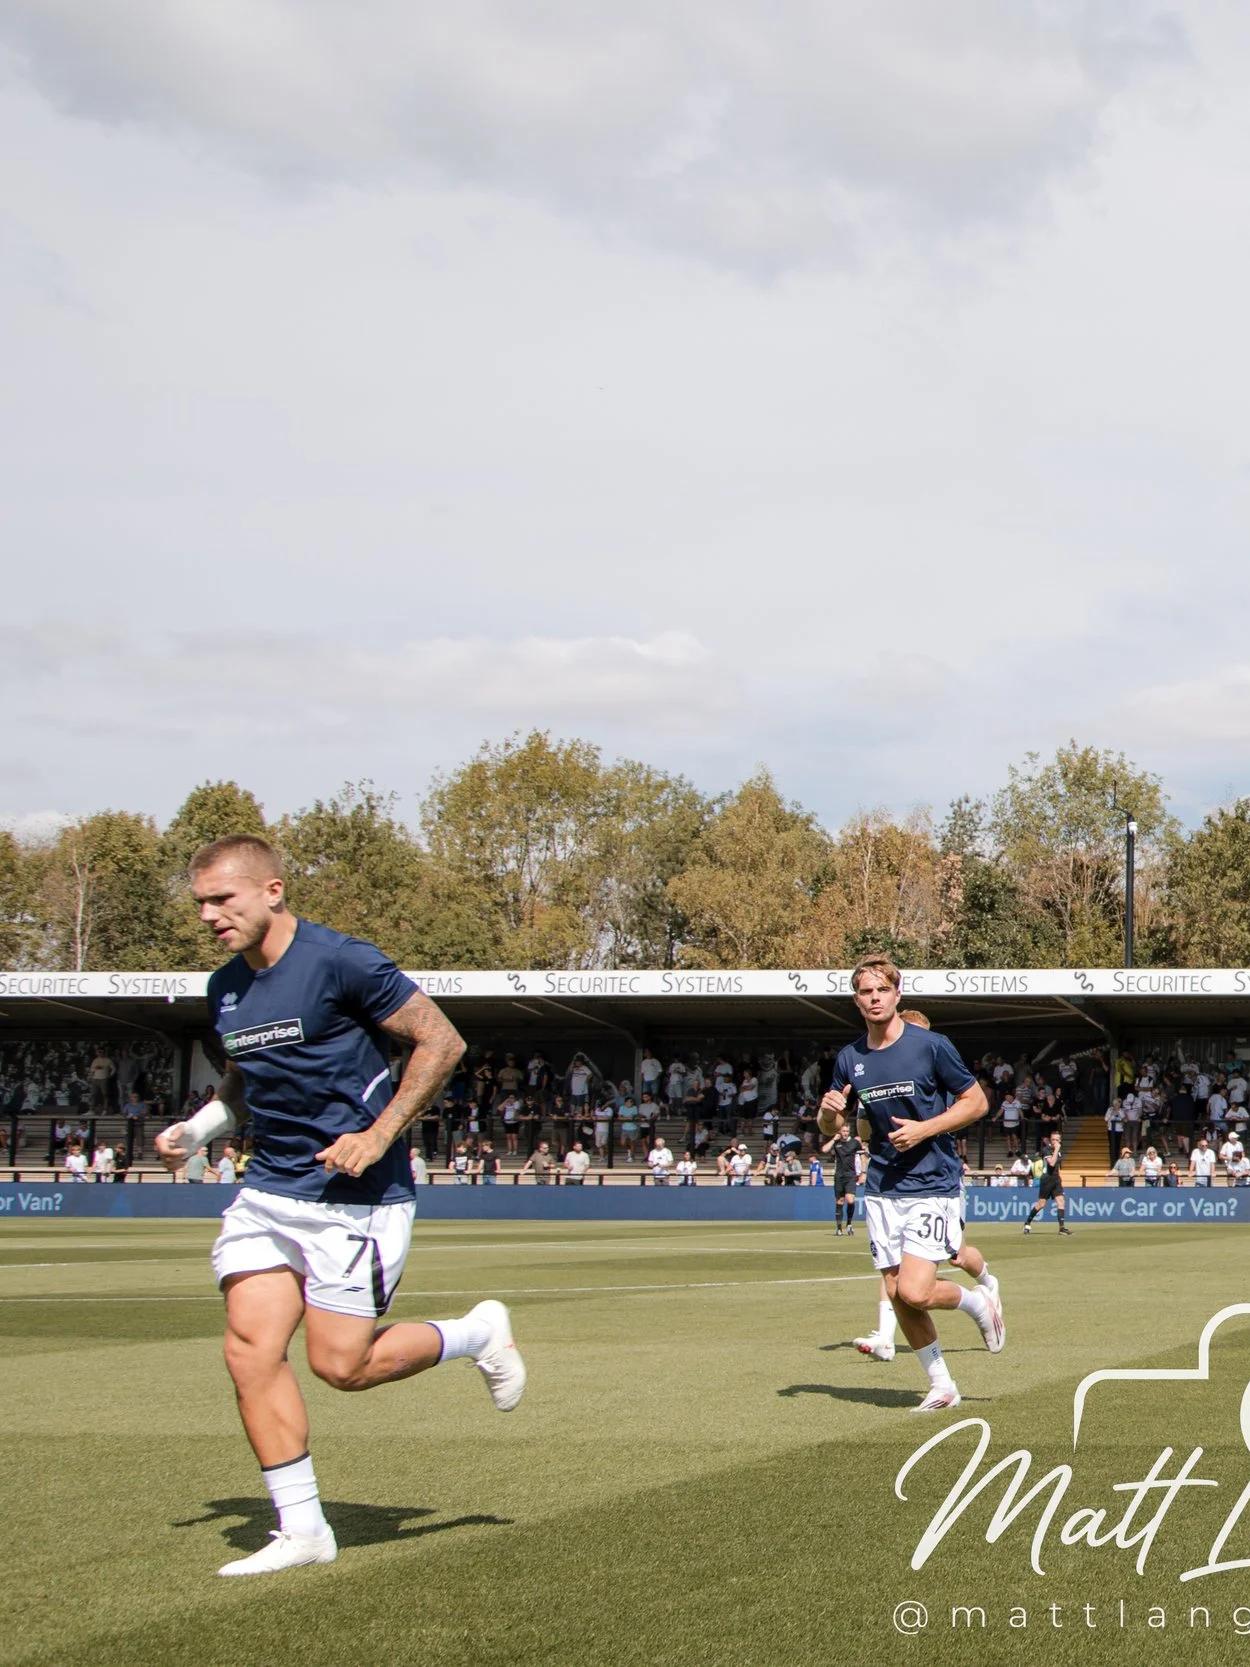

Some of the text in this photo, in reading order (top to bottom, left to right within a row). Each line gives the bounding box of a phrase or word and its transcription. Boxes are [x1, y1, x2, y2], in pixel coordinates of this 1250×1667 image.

[108, 974, 187, 994] SYSTEMS
[544, 972, 743, 993] SECURITEC SYSTEMS
[945, 971, 1028, 993] SYSTEMS
[1112, 971, 1212, 992] SECURITEC
[224, 1026, 300, 1050] enterprise
[861, 1085, 913, 1100] enterprise
[18, 1193, 63, 1211] Van?
[1069, 1199, 1114, 1216] New
[1121, 1198, 1157, 1216] Car
[1163, 1201, 1185, 1216] or
[1189, 1198, 1238, 1217] Van?
[917, 1213, 944, 1242] 30
[341, 1234, 369, 1278] 7
